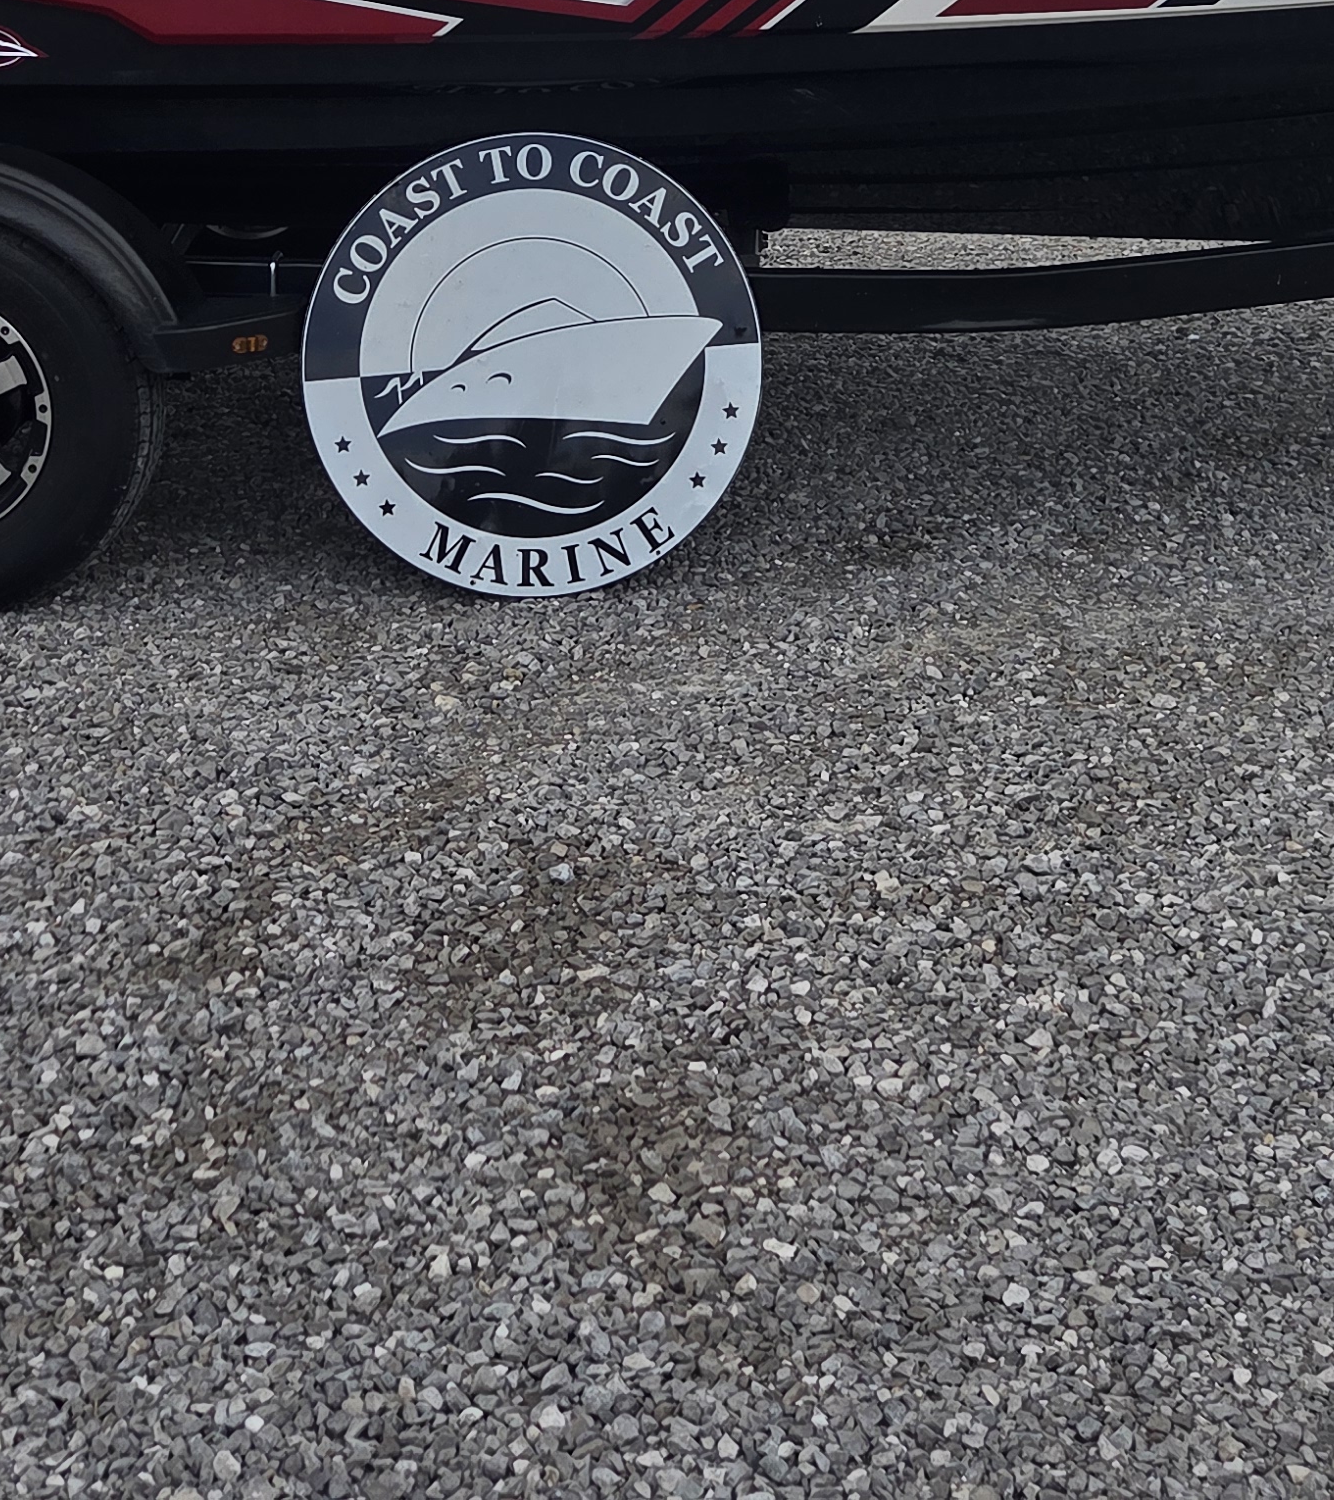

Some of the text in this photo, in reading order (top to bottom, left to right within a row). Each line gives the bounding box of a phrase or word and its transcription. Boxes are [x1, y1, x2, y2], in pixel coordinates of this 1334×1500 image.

[333, 143, 725, 304] COAST TO COAST
[419, 506, 676, 587] MARINE
